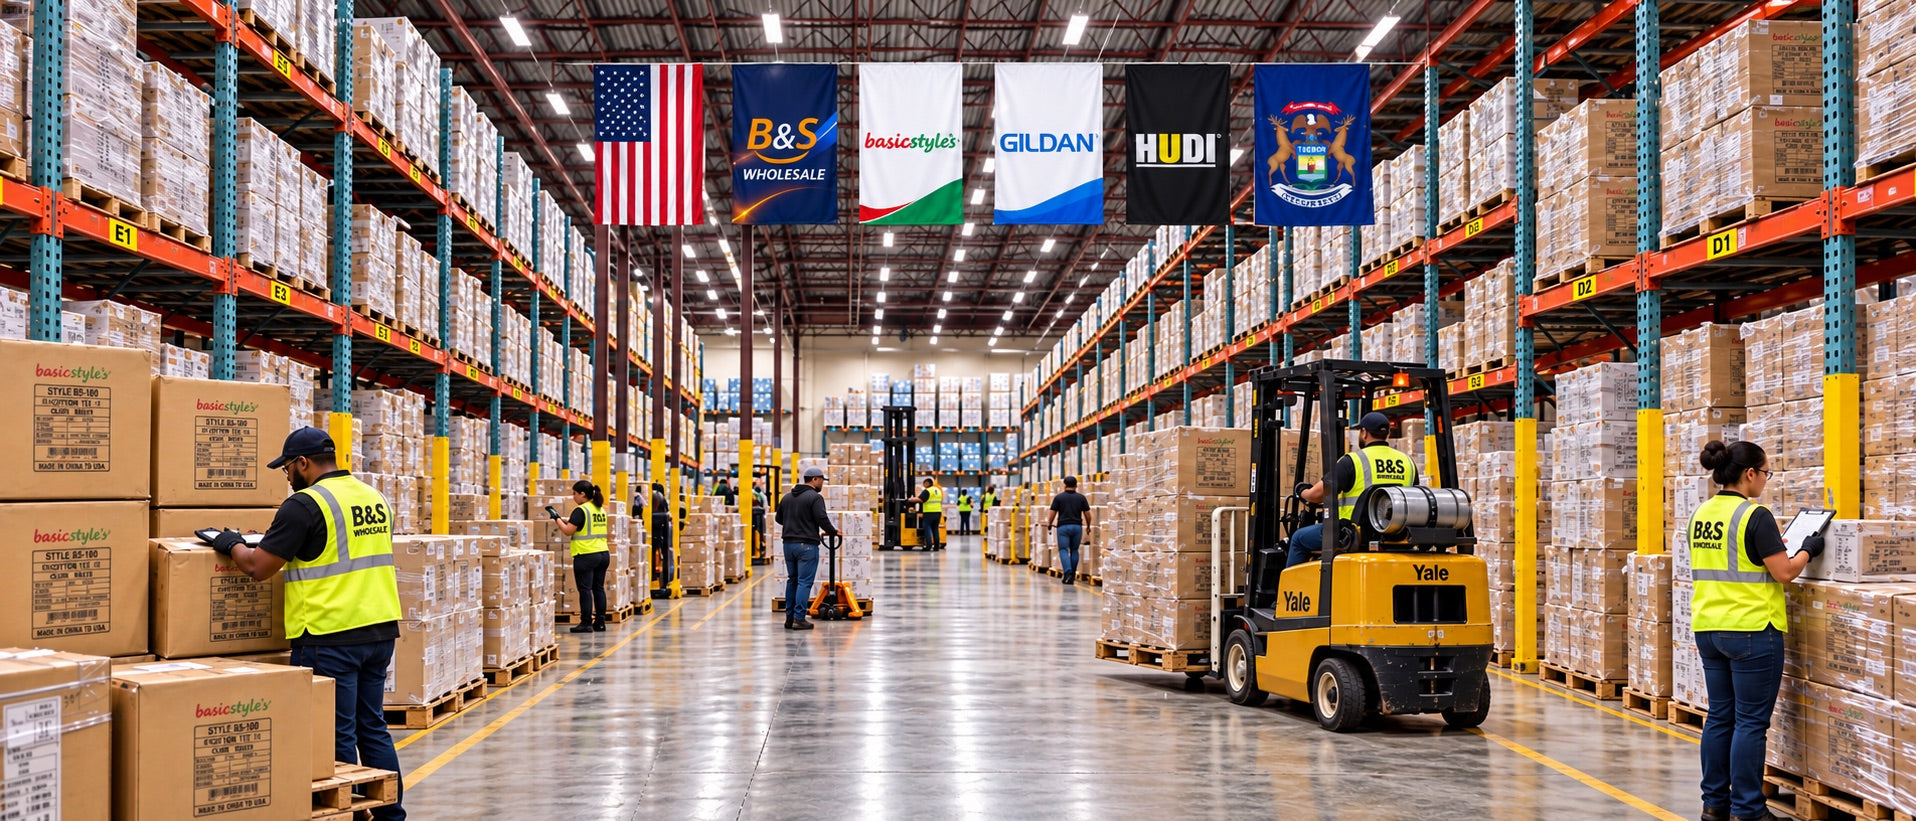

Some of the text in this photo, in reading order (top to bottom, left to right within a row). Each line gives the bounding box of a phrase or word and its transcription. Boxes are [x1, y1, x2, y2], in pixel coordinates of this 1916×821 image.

[747, 117, 819, 150] B&S
[1000, 133, 1094, 153] GILDAN
[1135, 133, 1216, 164] HUDI
[743, 168, 826, 181] WHOLESALE
[116, 224, 131, 245] E1
[1713, 233, 1730, 255] D1
[275, 285, 287, 301] E3
[1578, 279, 1592, 296] D2
[47, 387, 71, 396] STYLE
[1375, 459, 1405, 474] B&S
[351, 503, 387, 527] B&S
[1693, 521, 1724, 540] B&S
[1412, 564, 1449, 581] Yale
[1283, 591, 1311, 612] Yale
